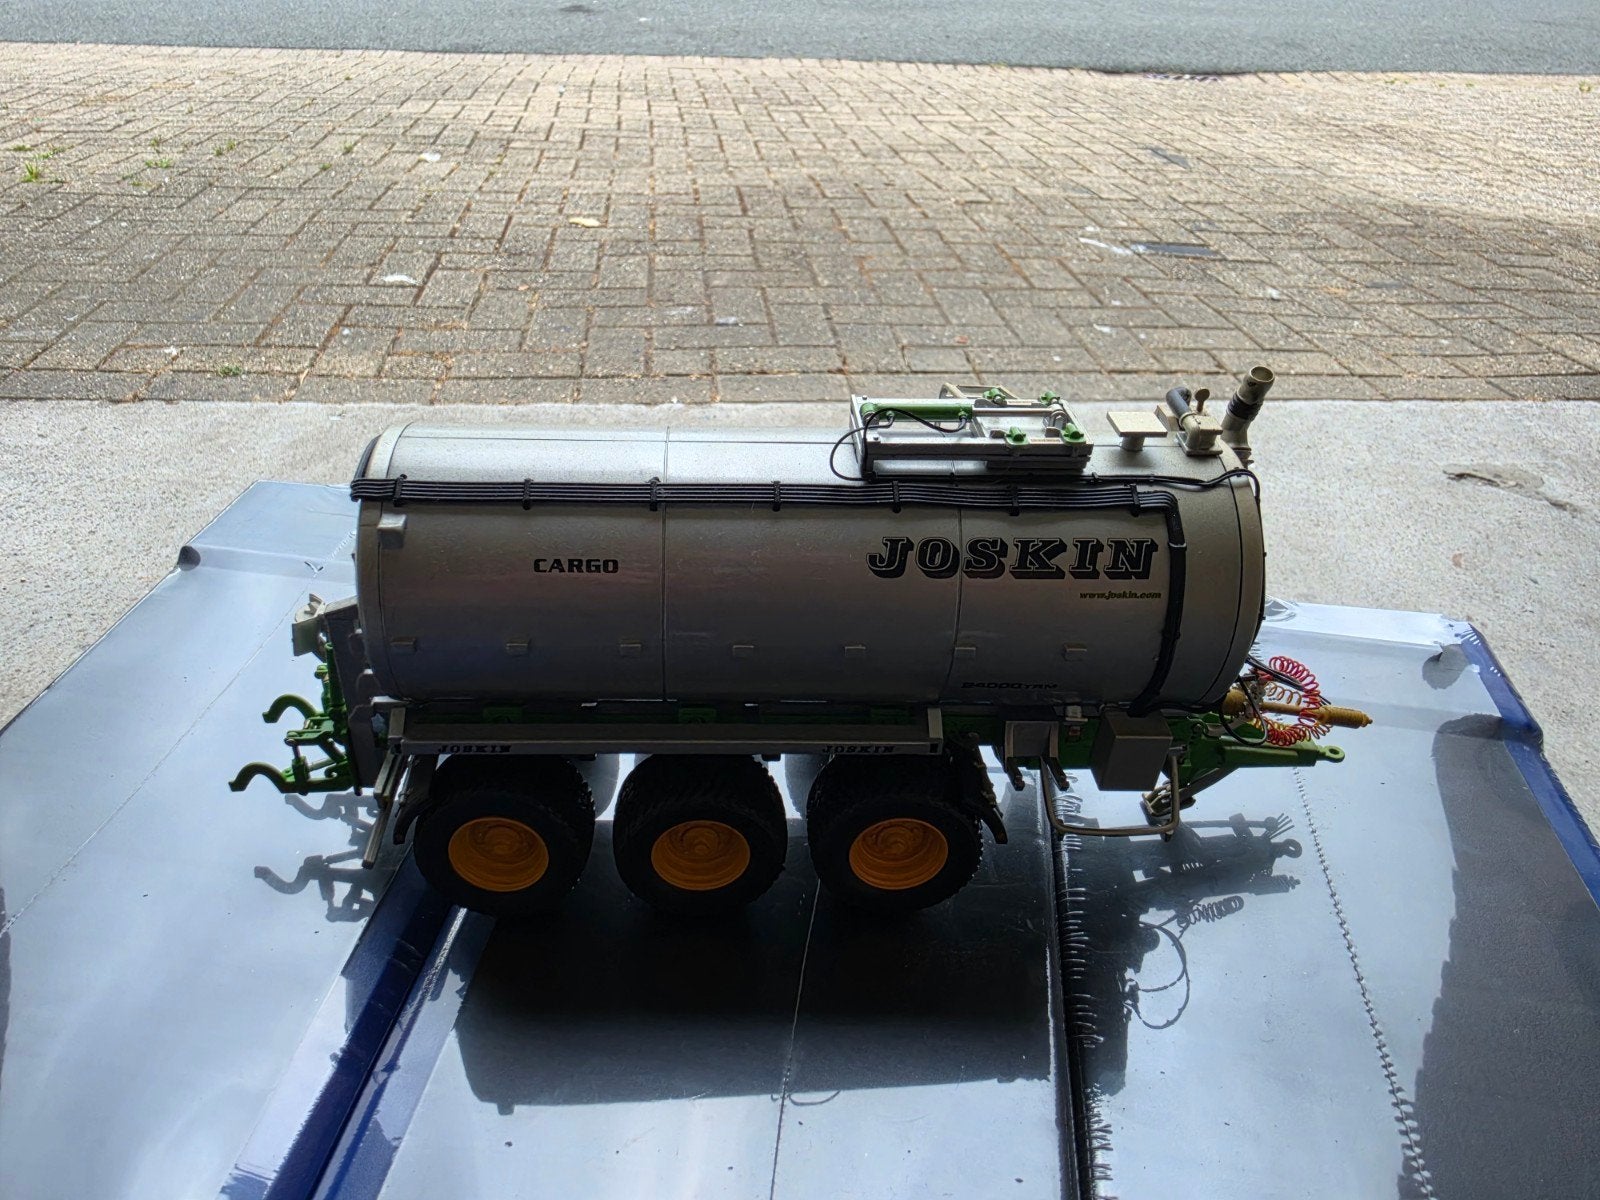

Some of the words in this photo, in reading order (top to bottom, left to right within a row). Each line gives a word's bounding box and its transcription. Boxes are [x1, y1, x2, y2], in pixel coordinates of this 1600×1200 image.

[866, 536, 1159, 579] JOSKIN
[533, 558, 619, 574] CARGO
[1079, 590, 1162, 601] www.joskin.com
[822, 744, 895, 753] JOSKIN
